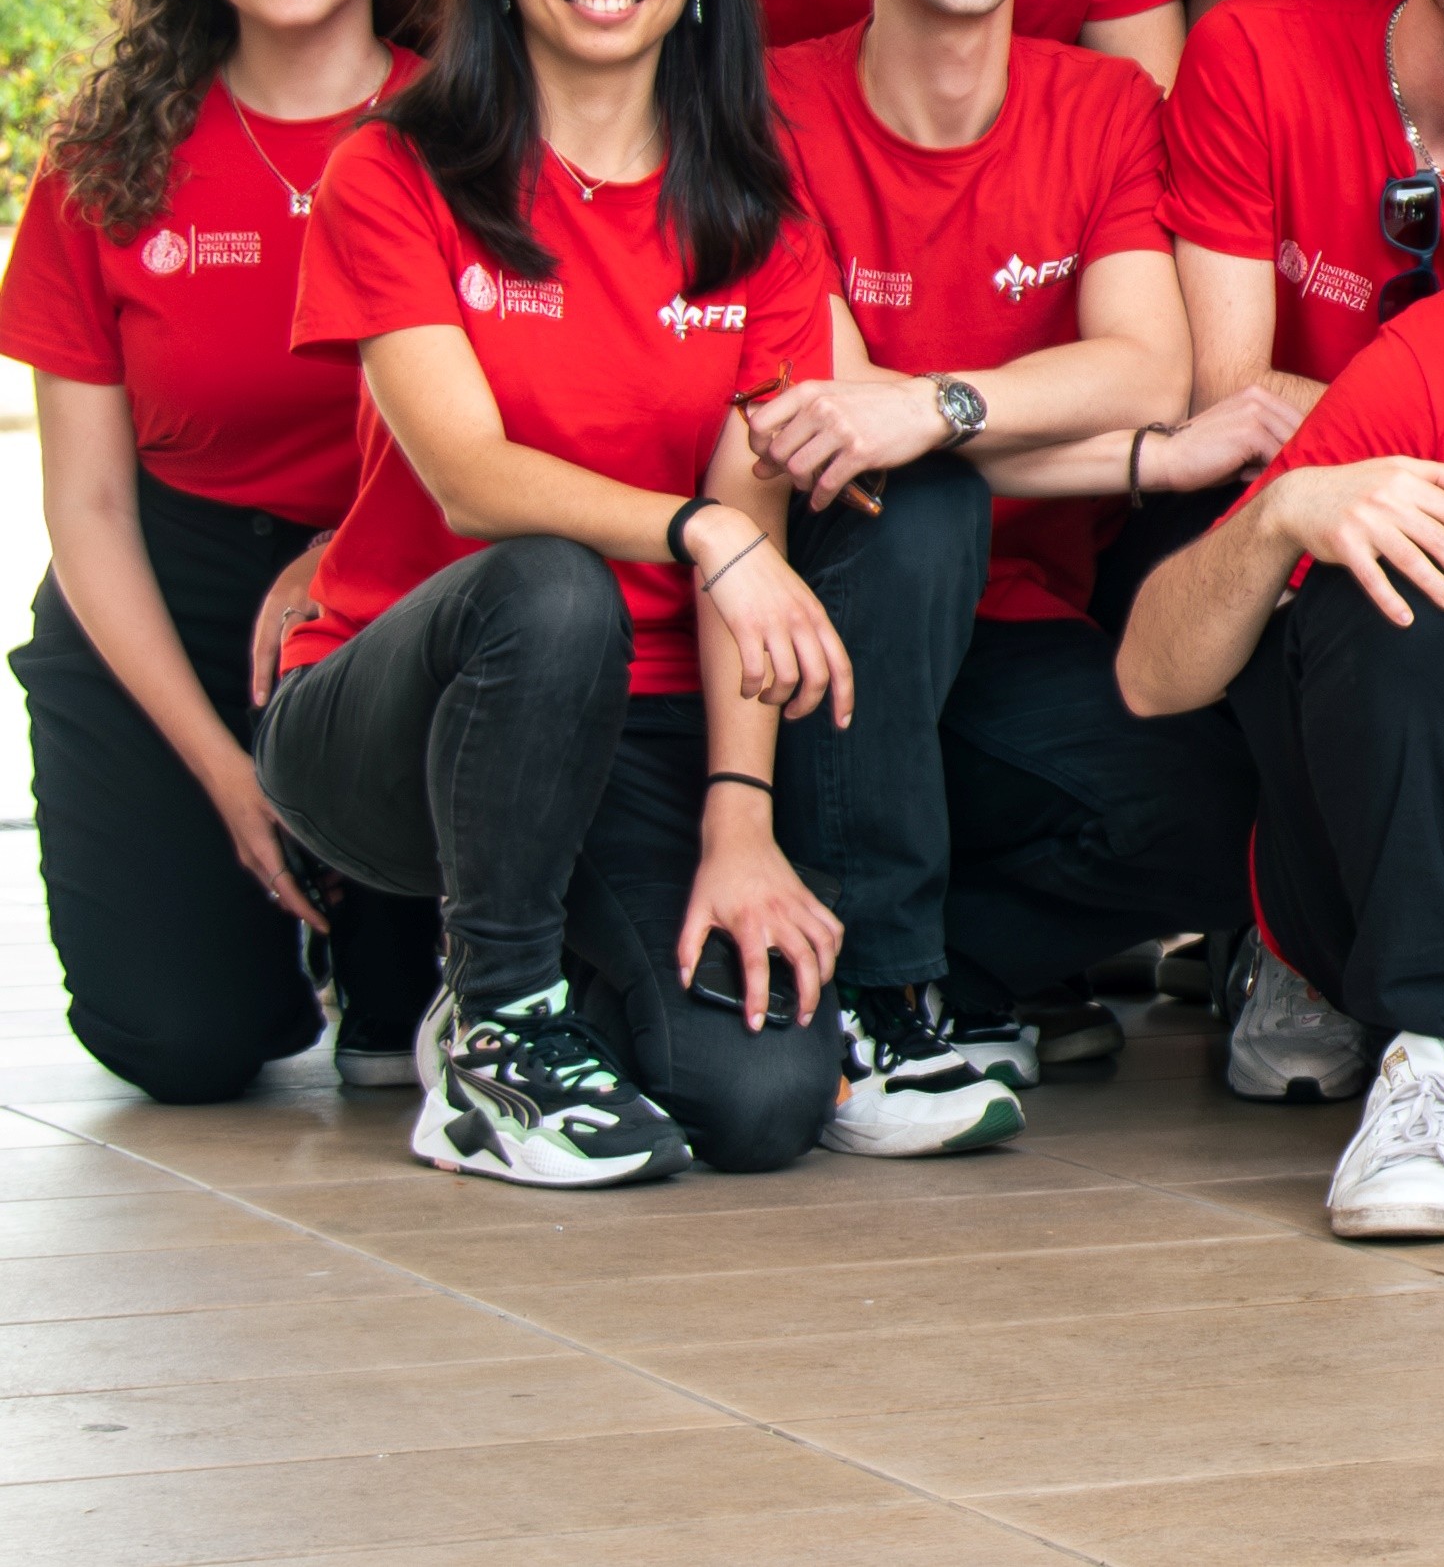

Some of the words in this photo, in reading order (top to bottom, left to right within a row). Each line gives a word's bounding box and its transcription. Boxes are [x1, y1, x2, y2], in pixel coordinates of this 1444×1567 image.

[200, 242, 231, 252] DEGLI
[233, 243, 262, 252] STUDI
[199, 252, 262, 265] FIRENZE
[857, 280, 887, 291] DEGLI
[887, 283, 913, 292] STUDI
[1316, 272, 1342, 288] DEGLI
[1343, 281, 1370, 299] STUDI
[506, 290, 537, 300] DEGLI
[538, 292, 563, 304] STUDI
[854, 290, 912, 307] FIRENZE
[1312, 282, 1368, 312] FIRENZE
[507, 299, 563, 319] FIRENZE
[704, 305, 747, 329] FR
